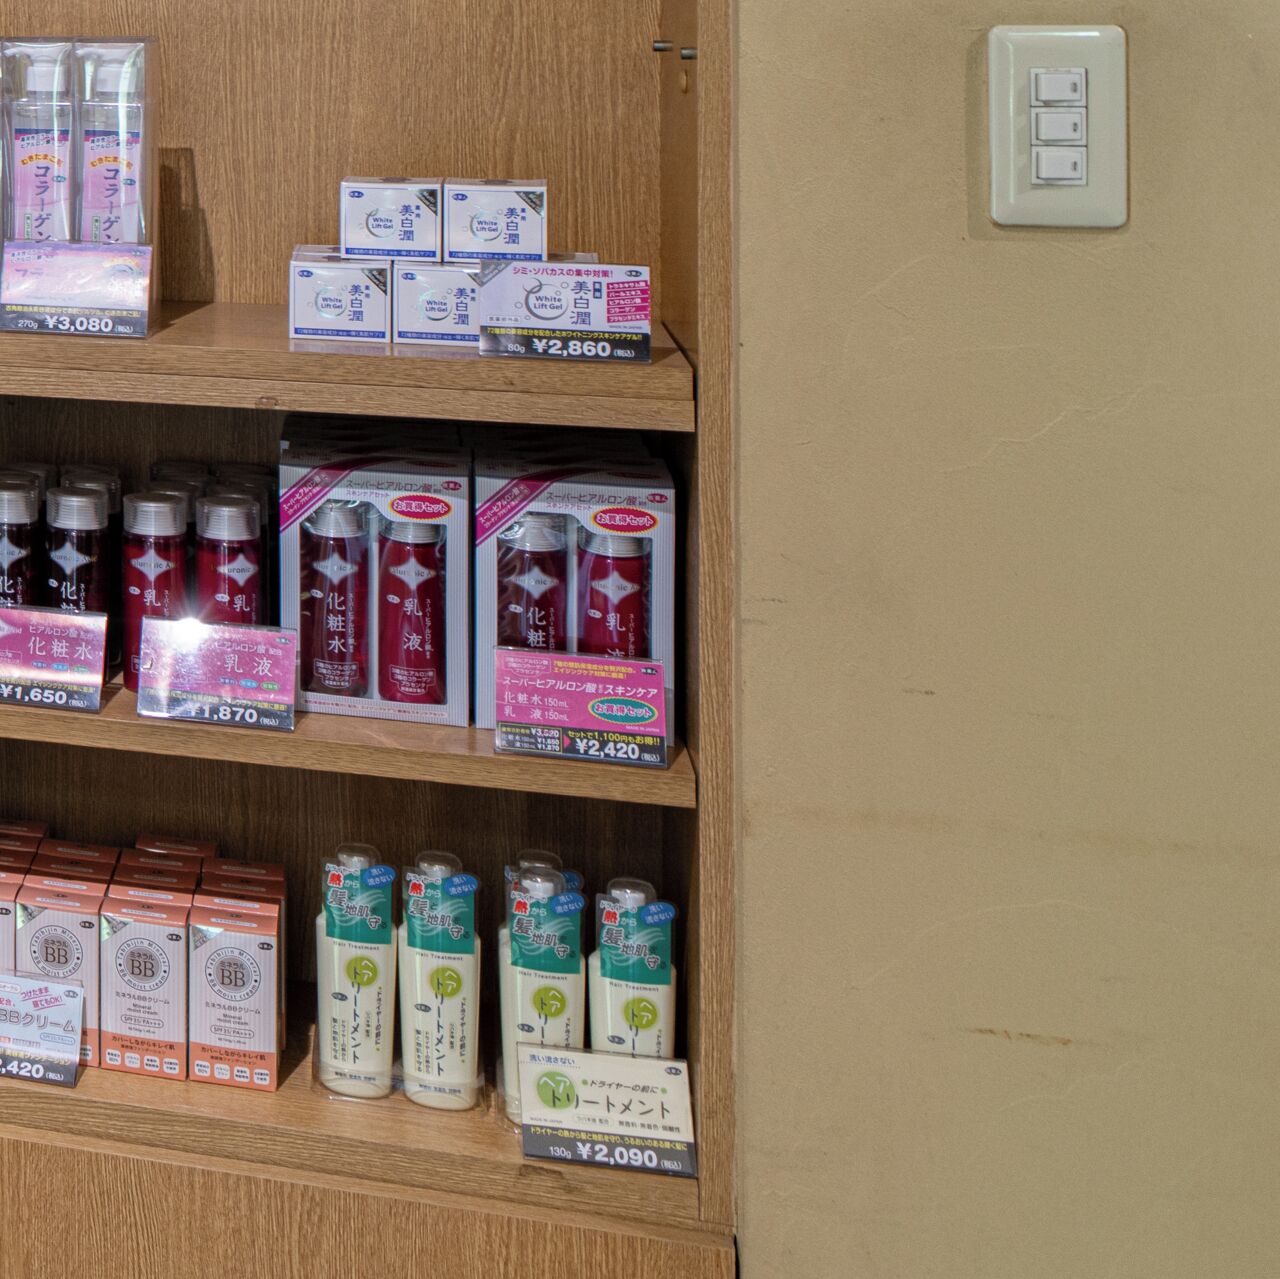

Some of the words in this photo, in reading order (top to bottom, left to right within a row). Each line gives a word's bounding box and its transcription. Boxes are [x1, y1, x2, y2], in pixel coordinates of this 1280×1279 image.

[399, 205, 414, 241] 美白潤
[513, 267, 613, 278] シミ・ソバカスの集中対策!
[570, 281, 591, 325] 美白潤
[18, 319, 38, 329] 270g
[44, 316, 112, 333] ¥3,080
[508, 344, 525, 353] 80g
[532, 339, 611, 356] ¥2,860
[393, 499, 448, 513] お買得セット
[597, 513, 654, 527] お買得セット
[327, 592, 346, 653] 化粧水
[403, 599, 423, 651] 乳液
[28, 637, 93, 660] 化粧水
[225, 654, 272, 676] 乳液
[0, 684, 66, 704] ¥1,650
[503, 677, 597, 693] スーパーヒアルロン酸
[605, 685, 658, 697] スキンケア
[504, 692, 542, 704] 化粧水
[544, 698, 568, 708] 150mL
[504, 706, 542, 720] 乳液
[595, 704, 652, 717] お買得セット
[576, 739, 639, 759] ¥2,420
[45, 946, 68, 964] BB
[131, 960, 154, 977] BB
[361, 960, 373, 981] ヘア
[221, 970, 245, 988] BB
[21, 987, 49, 998] つけたまま
[32, 996, 62, 1007] 寝てもOK!
[351, 967, 361, 1064] トリートメント
[112, 1036, 175, 1050] カバーしながらキレイ肌
[529, 1054, 575, 1064] 洗い流さない
[540, 1077, 570, 1093] ヘア
[590, 1080, 658, 1093] ドライヤーの前に
[552, 1090, 670, 1119] トリートメント
[549, 1147, 571, 1158] 130g
[577, 1142, 657, 1167] ¥2,090
